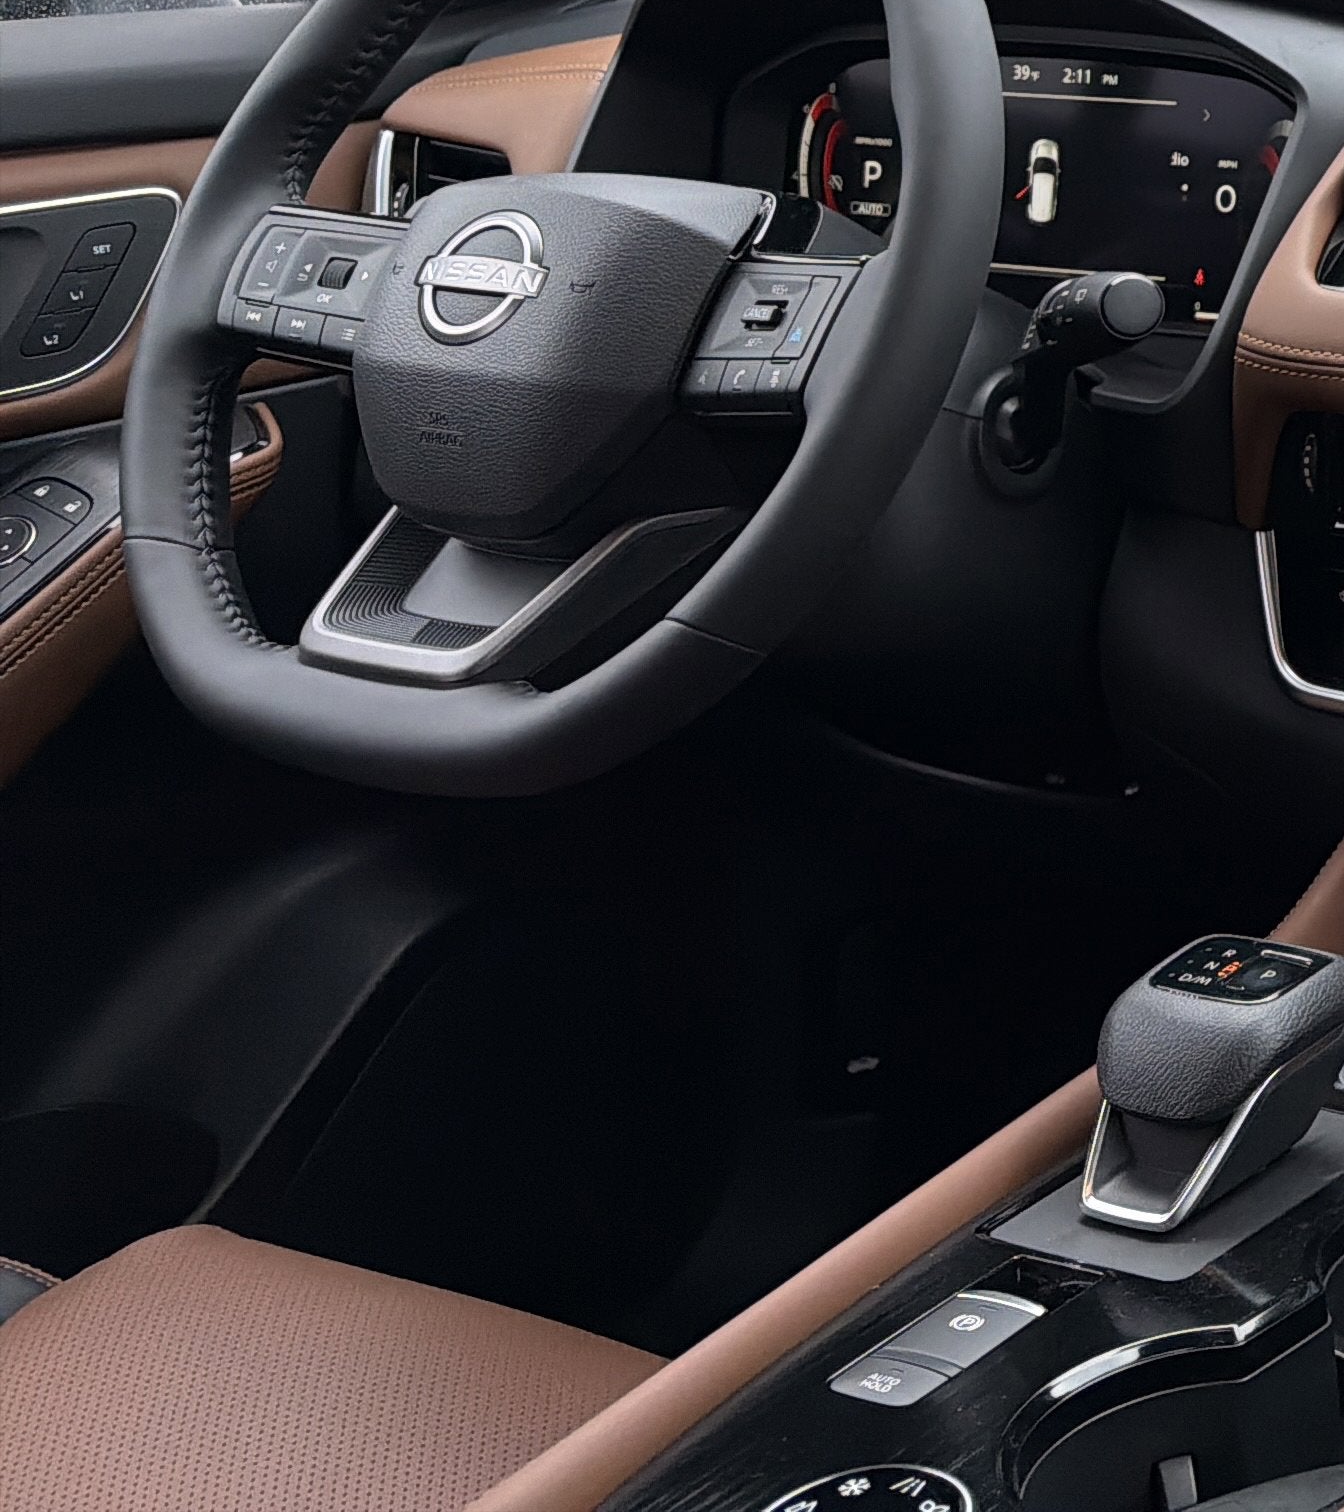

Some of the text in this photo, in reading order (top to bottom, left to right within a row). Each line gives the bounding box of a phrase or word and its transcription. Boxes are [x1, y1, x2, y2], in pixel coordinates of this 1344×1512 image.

[1062, 65, 1092, 85] 2:11
[1102, 74, 1119, 86] PM
[1217, 159, 1240, 170] MPH
[861, 160, 883, 188] P
[1215, 184, 1238, 213] 0
[857, 203, 884, 215] AUTO
[92, 244, 111, 255] SET
[421, 257, 544, 294] NISSAN
[316, 293, 332, 304] OK
[1221, 949, 1237, 958] R
[1203, 961, 1220, 971] N
[1178, 973, 1212, 986] D/M
[1259, 969, 1277, 979] P
[858, 1378, 892, 1393] HOLD
[867, 1373, 902, 1386] AUTO
